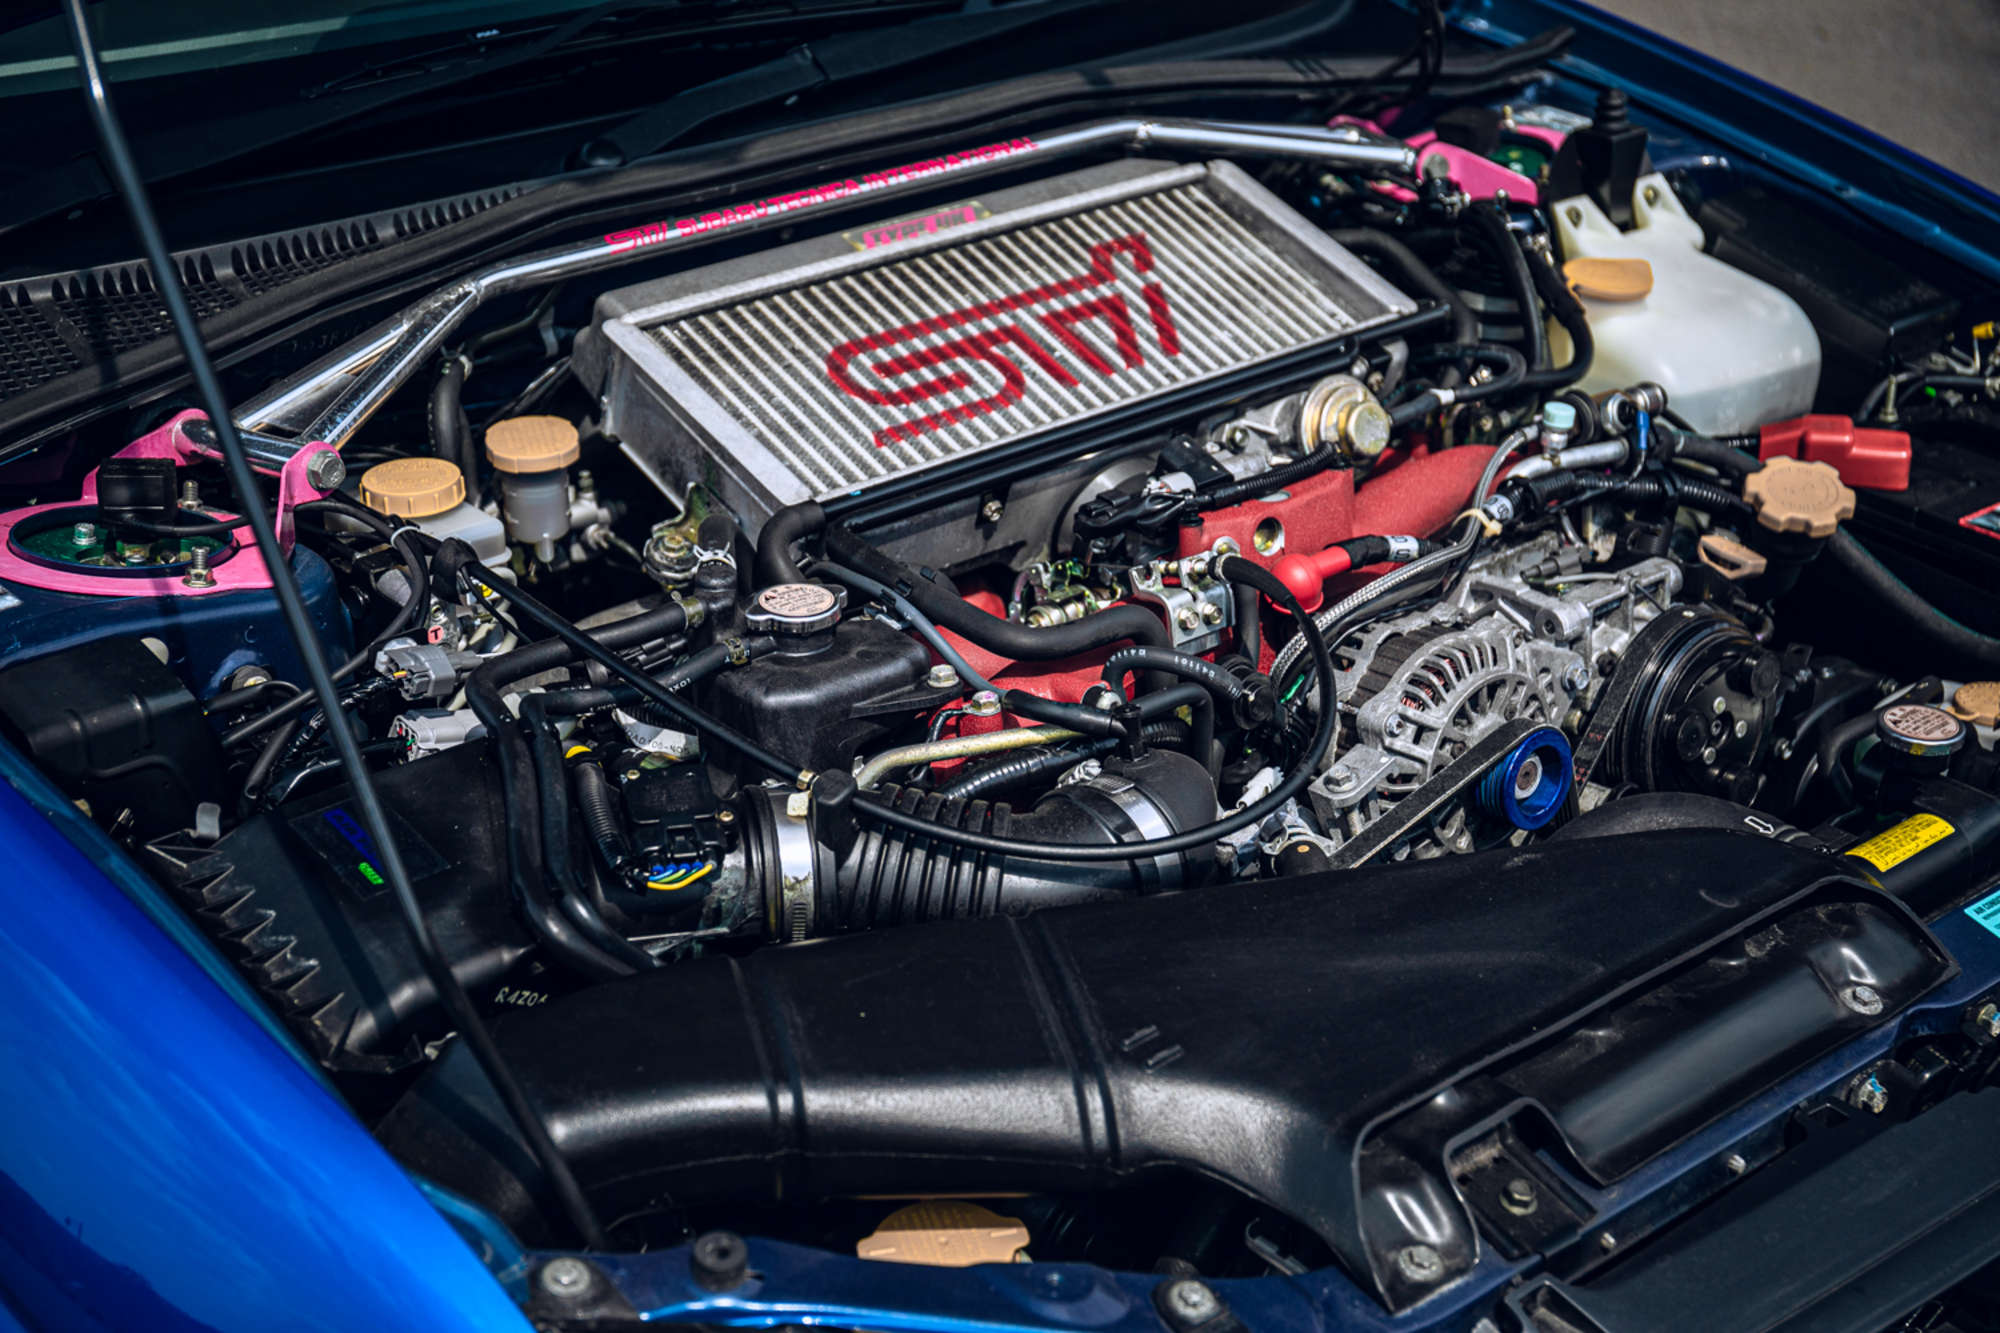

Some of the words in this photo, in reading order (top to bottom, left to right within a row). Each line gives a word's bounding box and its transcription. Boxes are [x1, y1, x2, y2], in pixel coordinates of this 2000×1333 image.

[675, 200, 768, 238] SUBARU
[766, 178, 863, 213] TECNICA
[862, 136, 1039, 191] INTERNATIONAL
